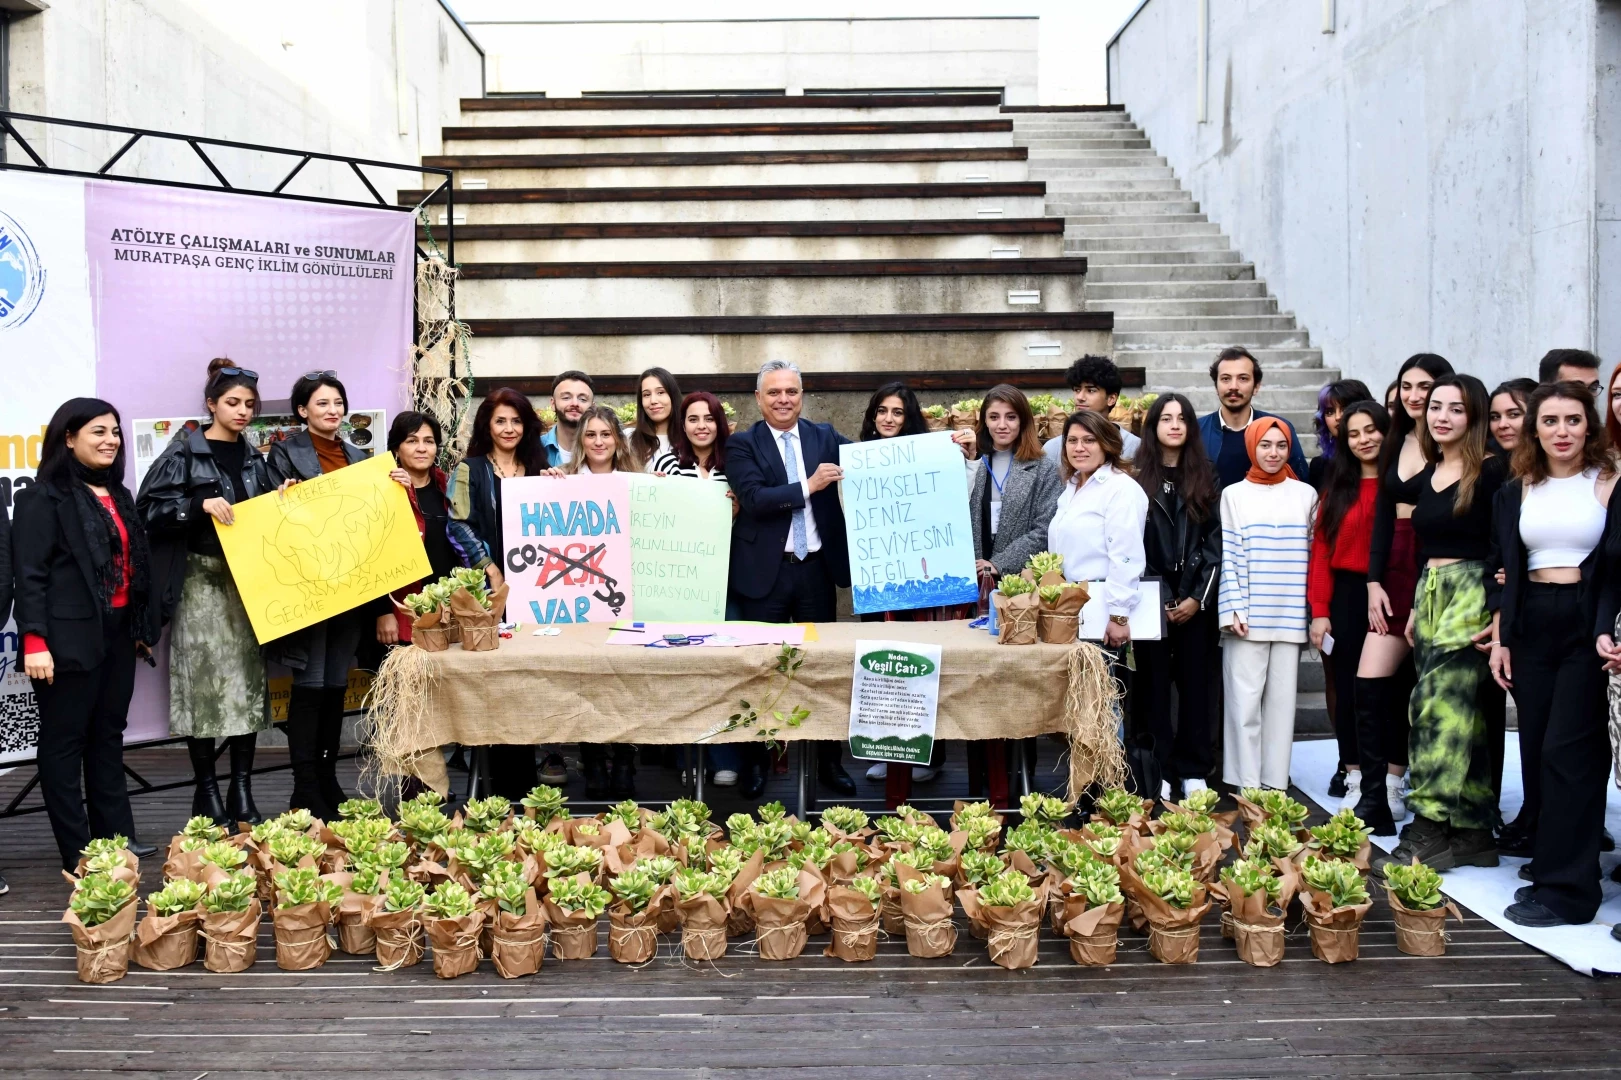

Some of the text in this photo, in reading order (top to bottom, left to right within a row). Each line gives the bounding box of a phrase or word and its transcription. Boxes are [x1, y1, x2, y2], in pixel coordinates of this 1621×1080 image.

[110, 227, 396, 264] ATÖLYE ÇALIŞMALARI ve SUNUMLAR
[114, 248, 394, 280] MURATPAŞA GENÇ İKLİM GÖNÜLLÜLERİ
[851, 440, 916, 470] SESİNİ
[852, 470, 941, 501] YÜKSELT
[520, 499, 621, 536] HAVADA
[853, 500, 916, 531] DENİZ
[856, 522, 954, 561] SEVİYESİNİ
[858, 560, 916, 587] DEĞİL
[528, 596, 591, 624] VAR
[868, 660, 892, 674] Yeşil
[895, 662, 918, 674] Çatı
[888, 653, 908, 662] Neden
